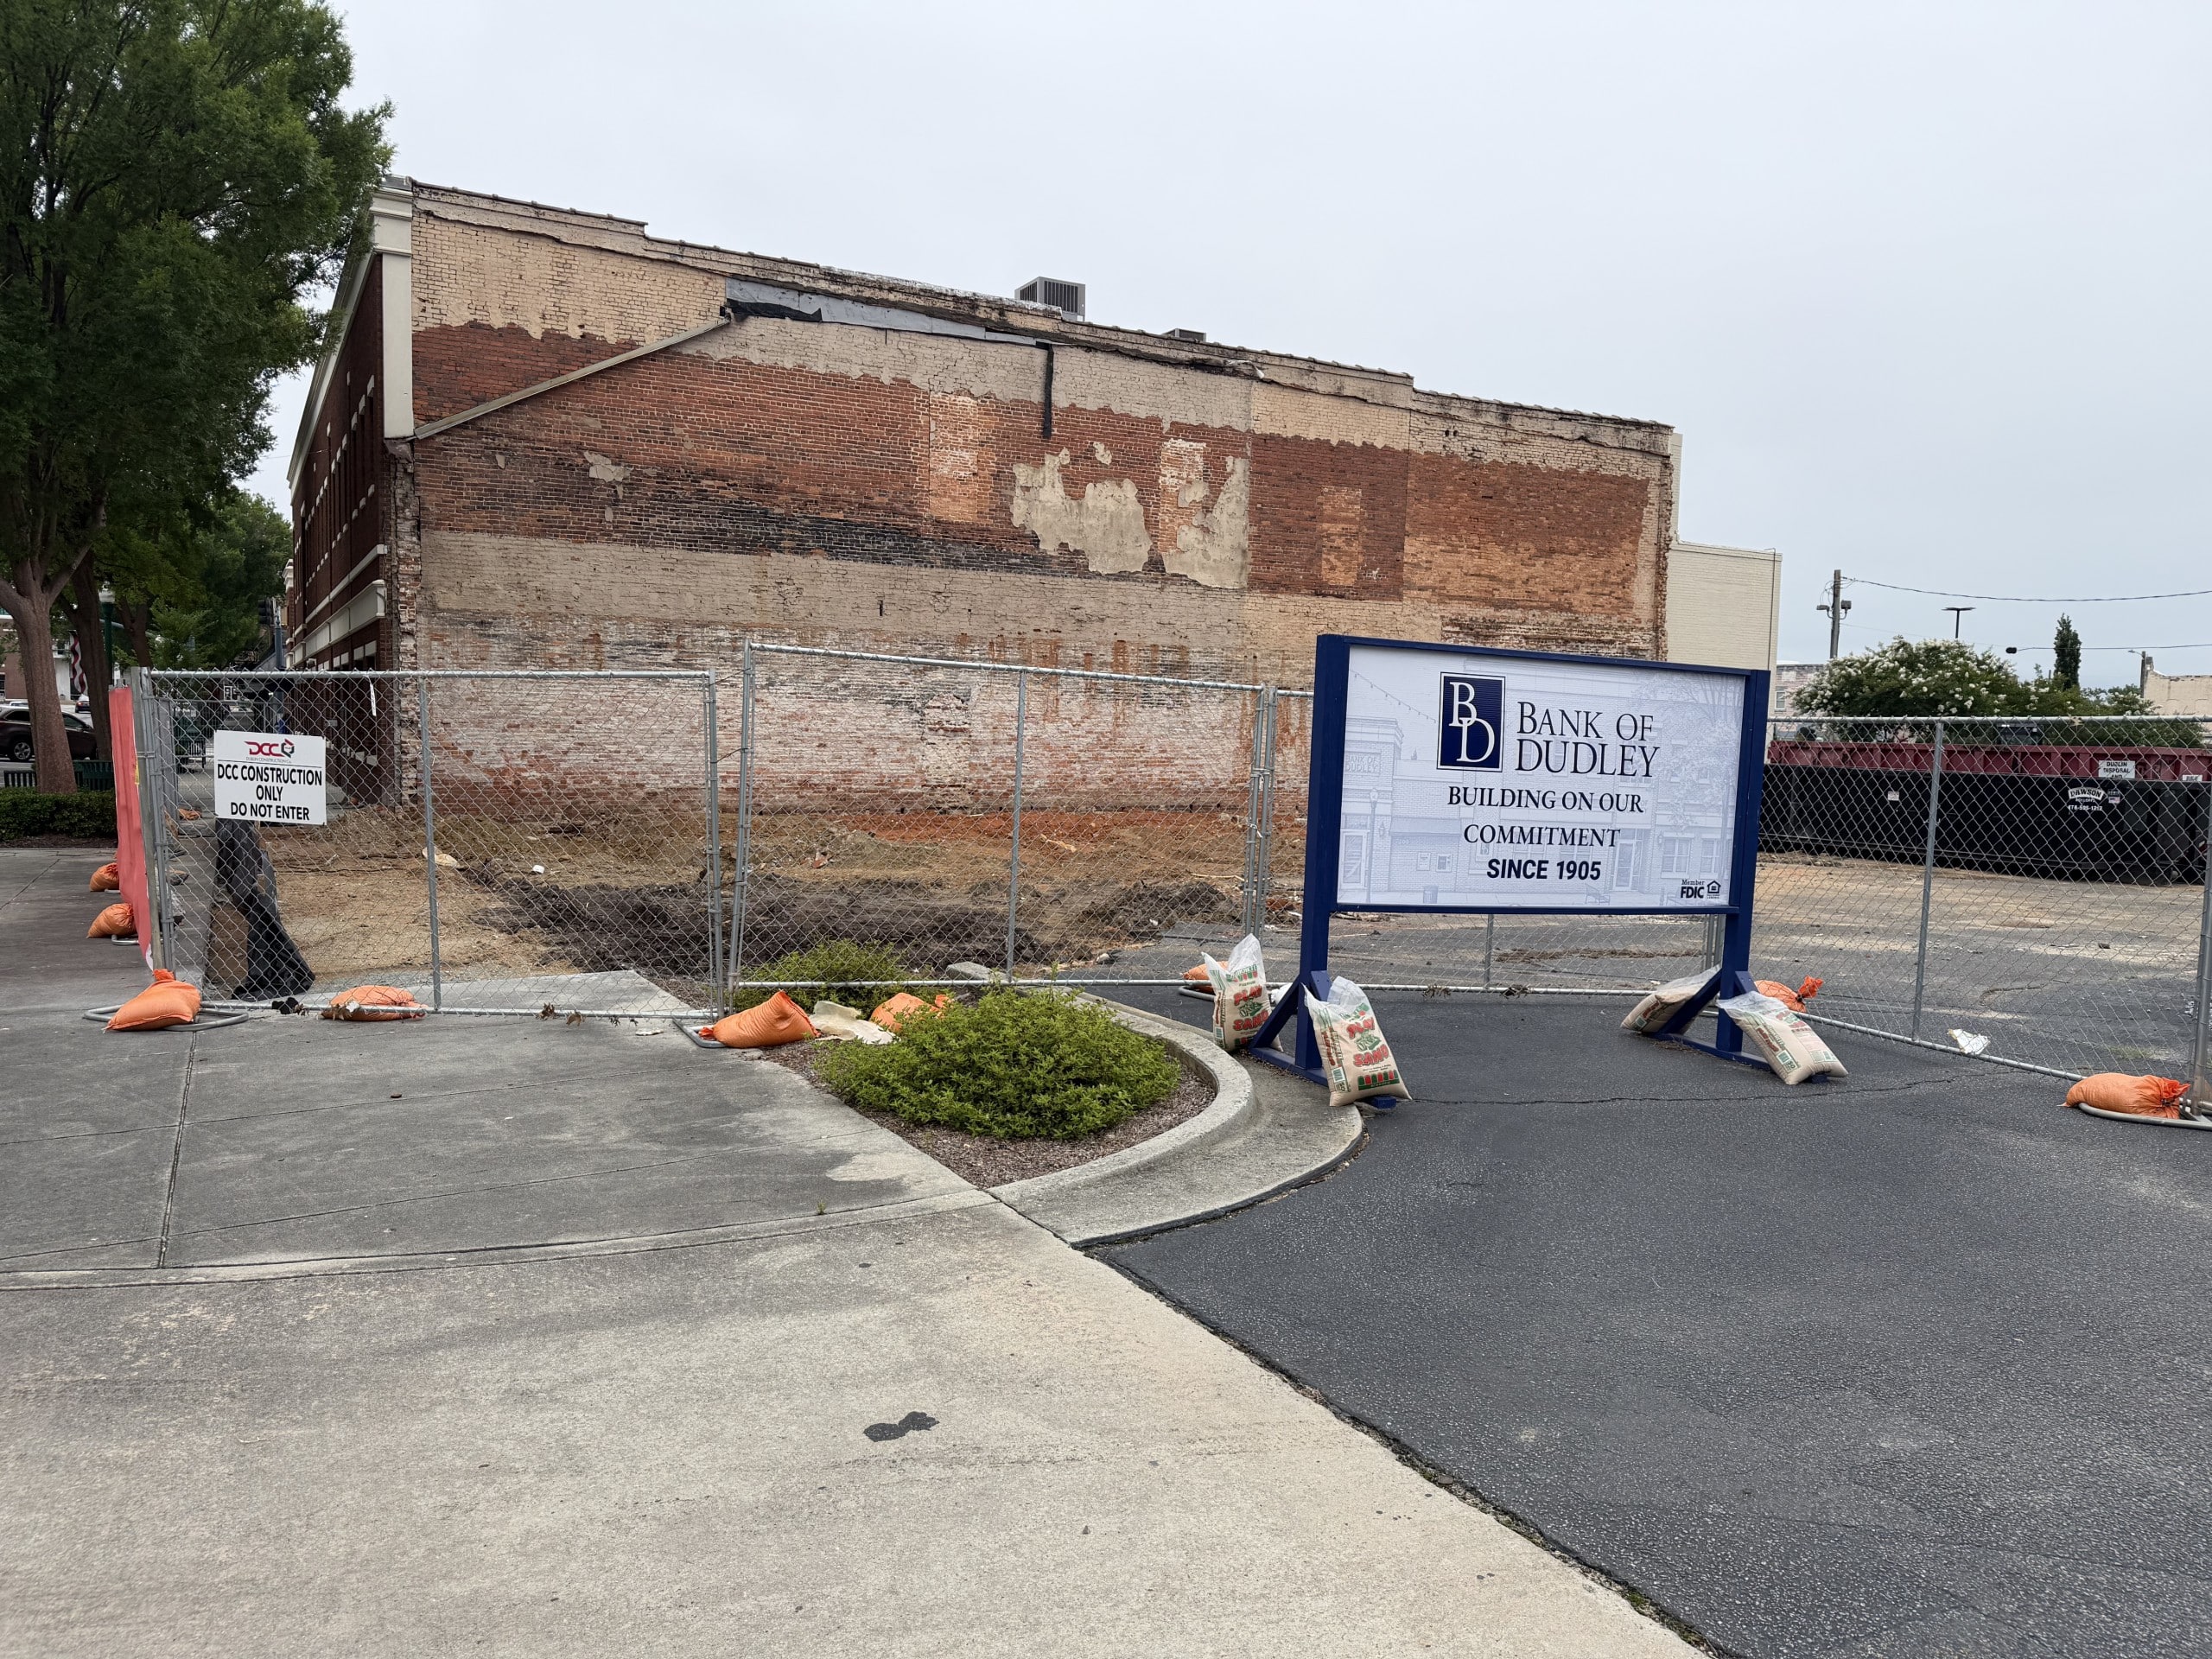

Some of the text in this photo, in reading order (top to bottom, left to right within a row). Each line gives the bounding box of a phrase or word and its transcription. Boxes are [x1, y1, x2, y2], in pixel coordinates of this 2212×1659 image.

[1516, 701, 1654, 741] BANK OF
[244, 741, 285, 757] DCC
[1515, 738, 1661, 778] DUDLEY
[218, 764, 322, 786] DCC CONSTRUCTION
[256, 785, 283, 802] ONLY
[1447, 785, 1644, 813] BUILDING ON OUR
[2069, 788, 2102, 798] DAWSON
[230, 802, 310, 821] DO NOT ENTER
[1463, 823, 1621, 848] COMMITMENT
[1486, 858, 1601, 880] SINCE 1905
[1680, 886, 1705, 899] FDIC
[1233, 985, 1263, 1007] PLAY
[1233, 1009, 1269, 1032] SAND
[1346, 1017, 1376, 1040] PLAY
[1353, 1044, 1389, 1068] SAND
